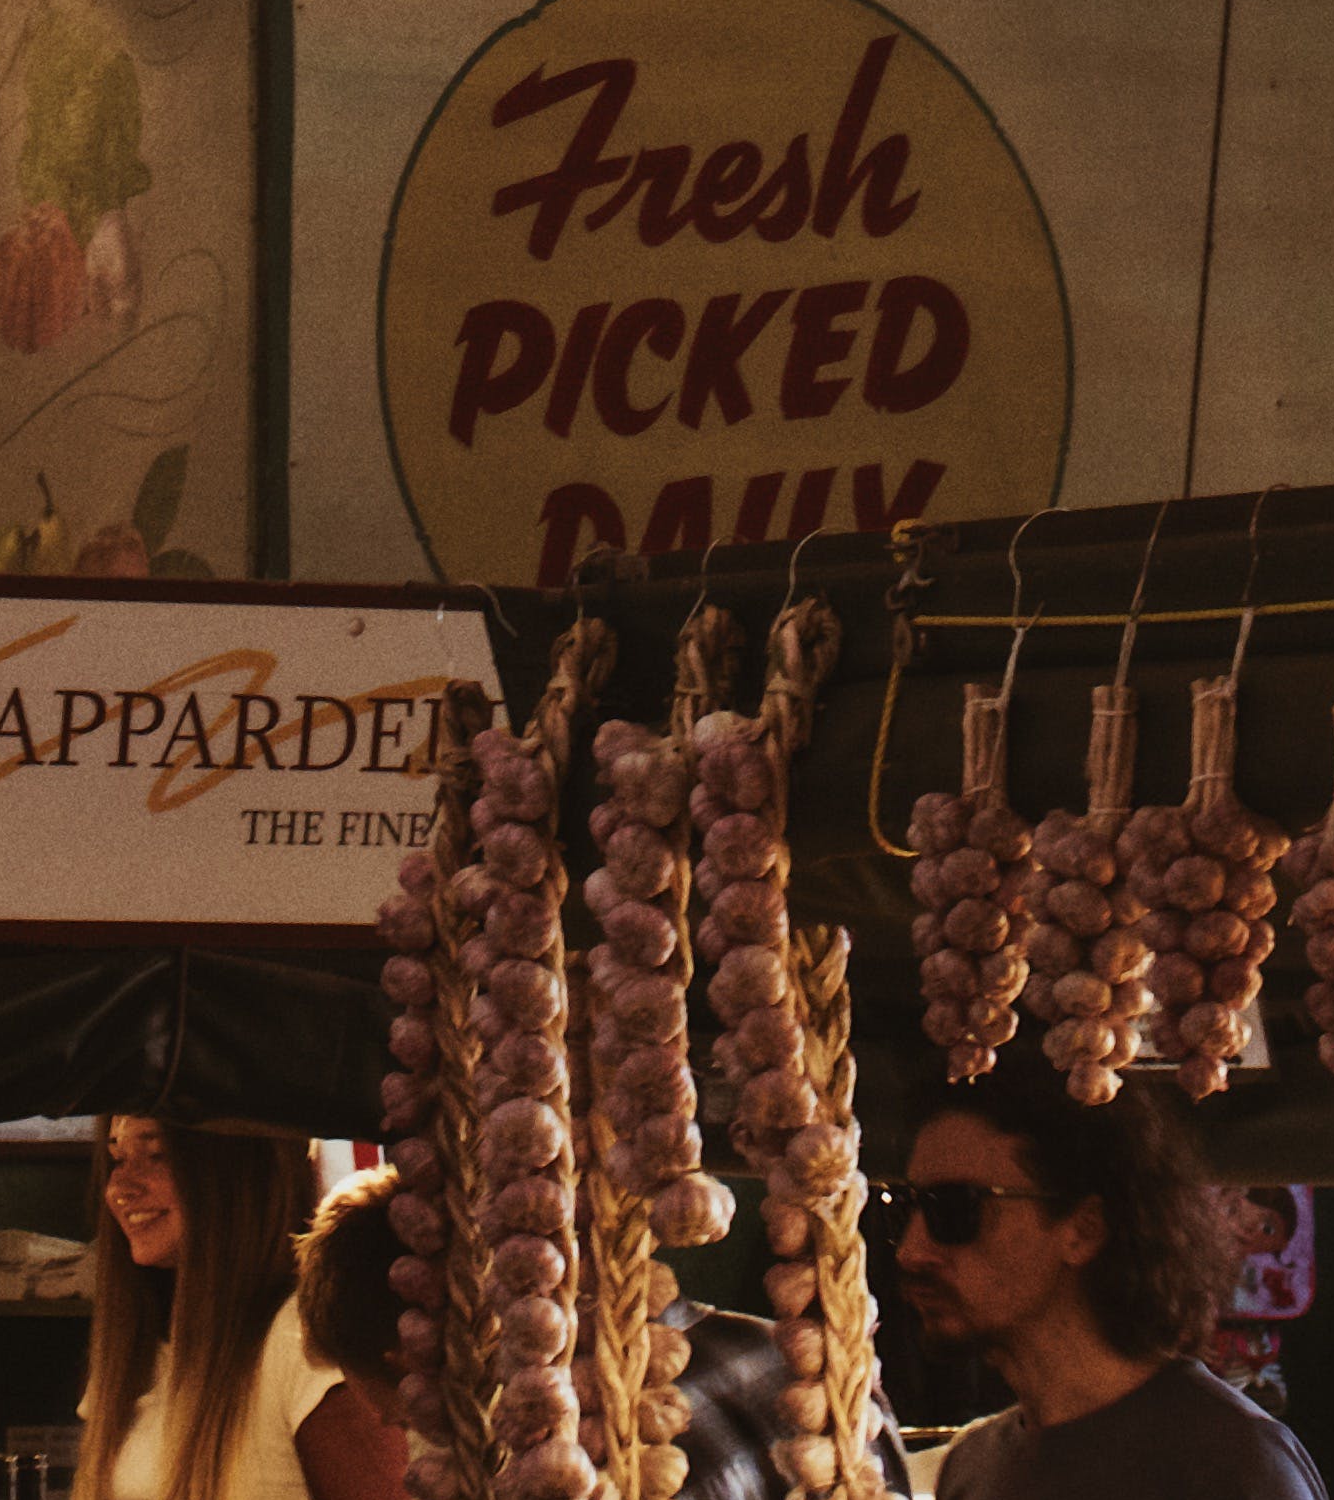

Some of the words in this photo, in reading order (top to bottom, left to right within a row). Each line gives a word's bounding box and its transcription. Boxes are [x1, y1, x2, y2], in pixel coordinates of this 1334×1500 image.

[492, 32, 921, 262] Fresh
[448, 275, 970, 448] PICKED
[241, 810, 323, 847] THE
